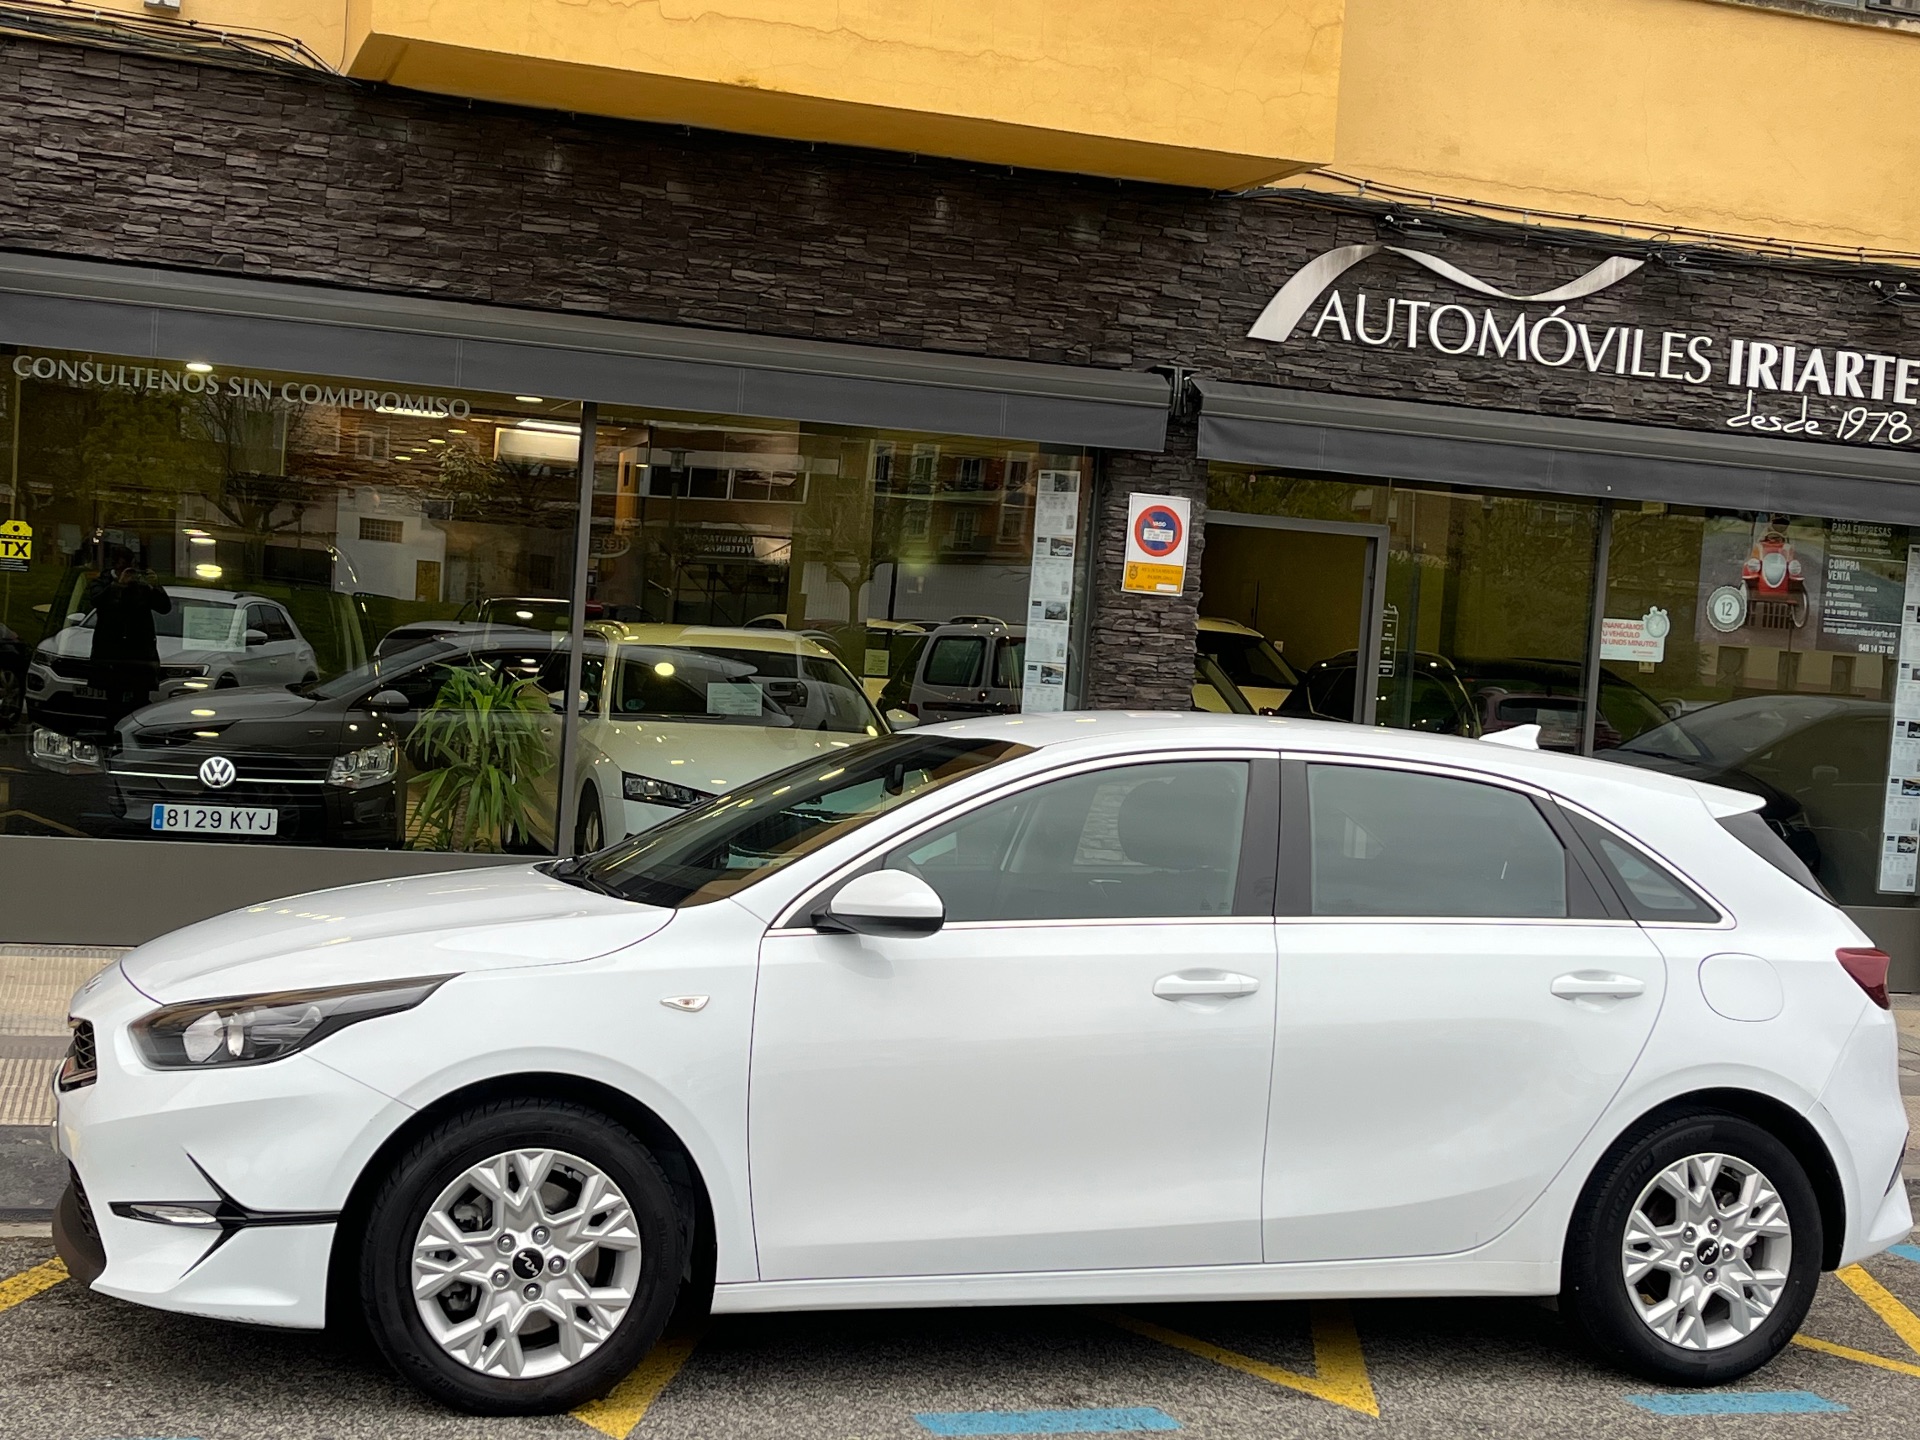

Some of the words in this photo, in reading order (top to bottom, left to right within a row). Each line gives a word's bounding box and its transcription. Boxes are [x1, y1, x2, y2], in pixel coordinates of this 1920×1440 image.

[1312, 289, 1714, 385] AUTOMÓVILES
[1727, 338, 1920, 405] IRIARTE
[12, 354, 220, 396] CONSULTENOS
[227, 376, 273, 401] SIN
[281, 380, 471, 420] COMPROMISO
[1726, 388, 1824, 436] desde
[1836, 406, 1914, 444] 1978
[1832, 522, 1851, 534] PARA
[1853, 524, 1892, 537] EMPRESAS
[1828, 558, 1860, 571] COMPRA
[1827, 570, 1851, 582] VENTA
[1721, 601, 1733, 617] 12
[1601, 621, 1644, 631] INANCIAMOS
[1628, 640, 1658, 648] MINUTOS
[166, 808, 222, 829] 8129
[230, 811, 271, 831] KYJ
